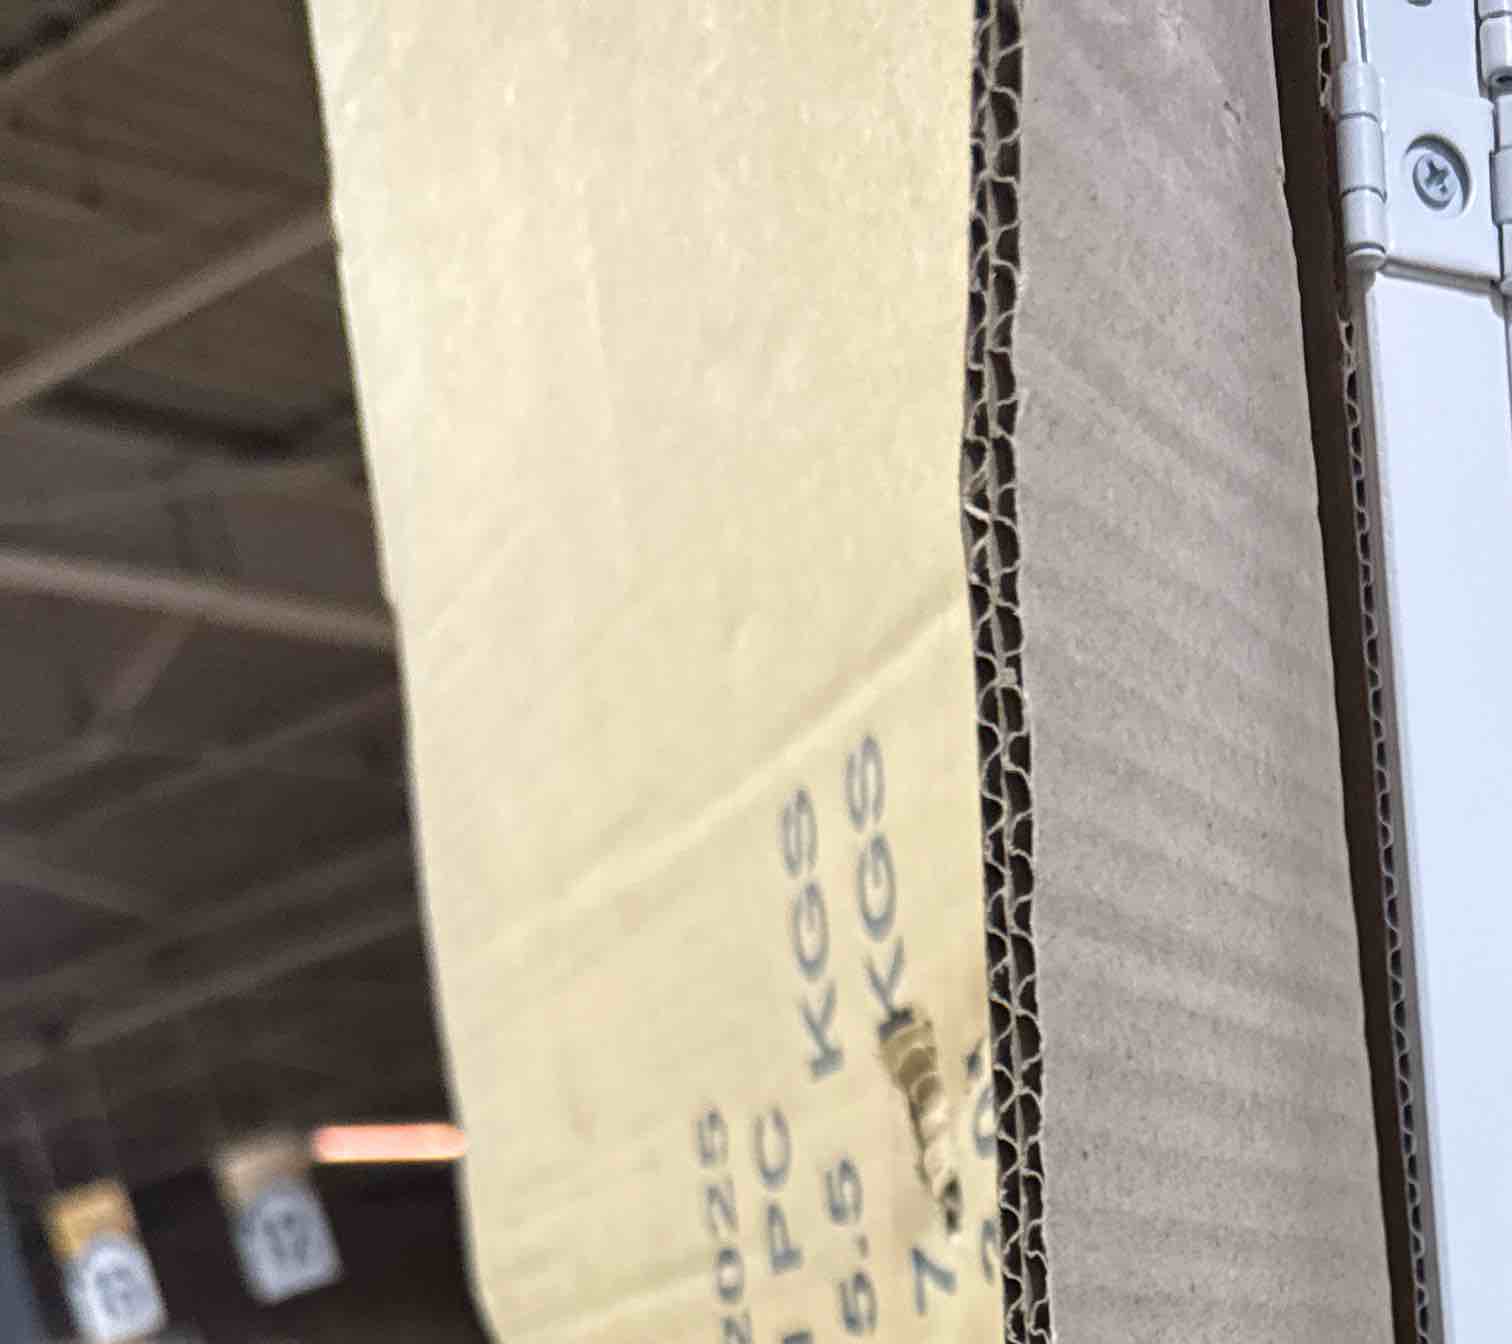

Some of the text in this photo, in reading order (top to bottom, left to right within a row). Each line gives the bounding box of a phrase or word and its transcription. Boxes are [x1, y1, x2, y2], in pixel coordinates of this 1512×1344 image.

[776, 785, 844, 1080] KGS
[844, 733, 914, 1040] KGS
[752, 1105, 803, 1274] PC
[822, 1155, 878, 1336] 5.5
